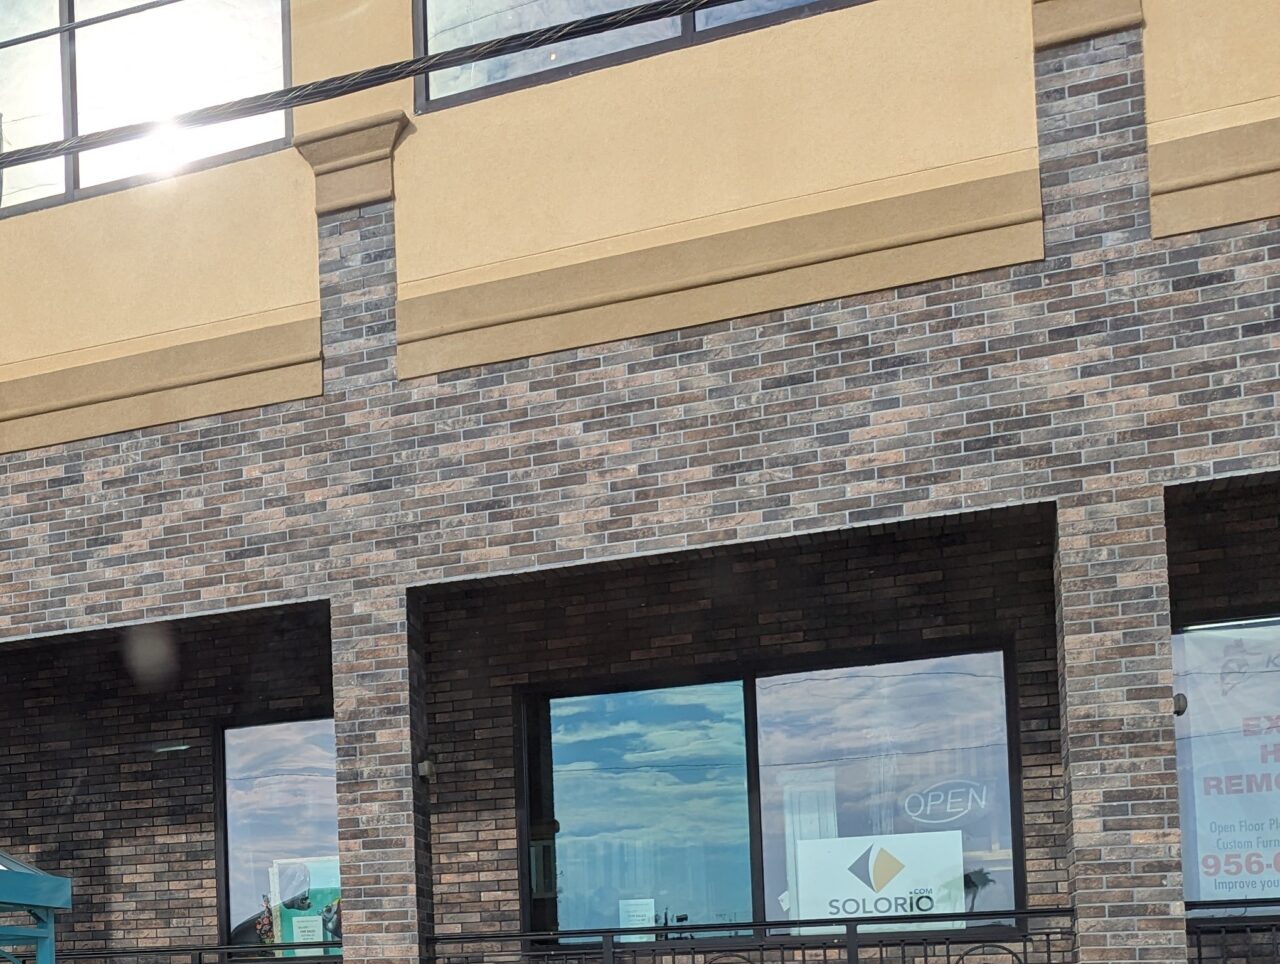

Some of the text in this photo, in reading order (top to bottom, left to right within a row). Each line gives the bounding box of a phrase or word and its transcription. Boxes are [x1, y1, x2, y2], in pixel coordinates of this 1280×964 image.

[904, 785, 987, 818] OPEN
[1209, 820, 1236, 836] Open
[1239, 819, 1265, 833] Floor
[1216, 837, 1253, 851] Custom
[1214, 878, 1257, 893] Improve
